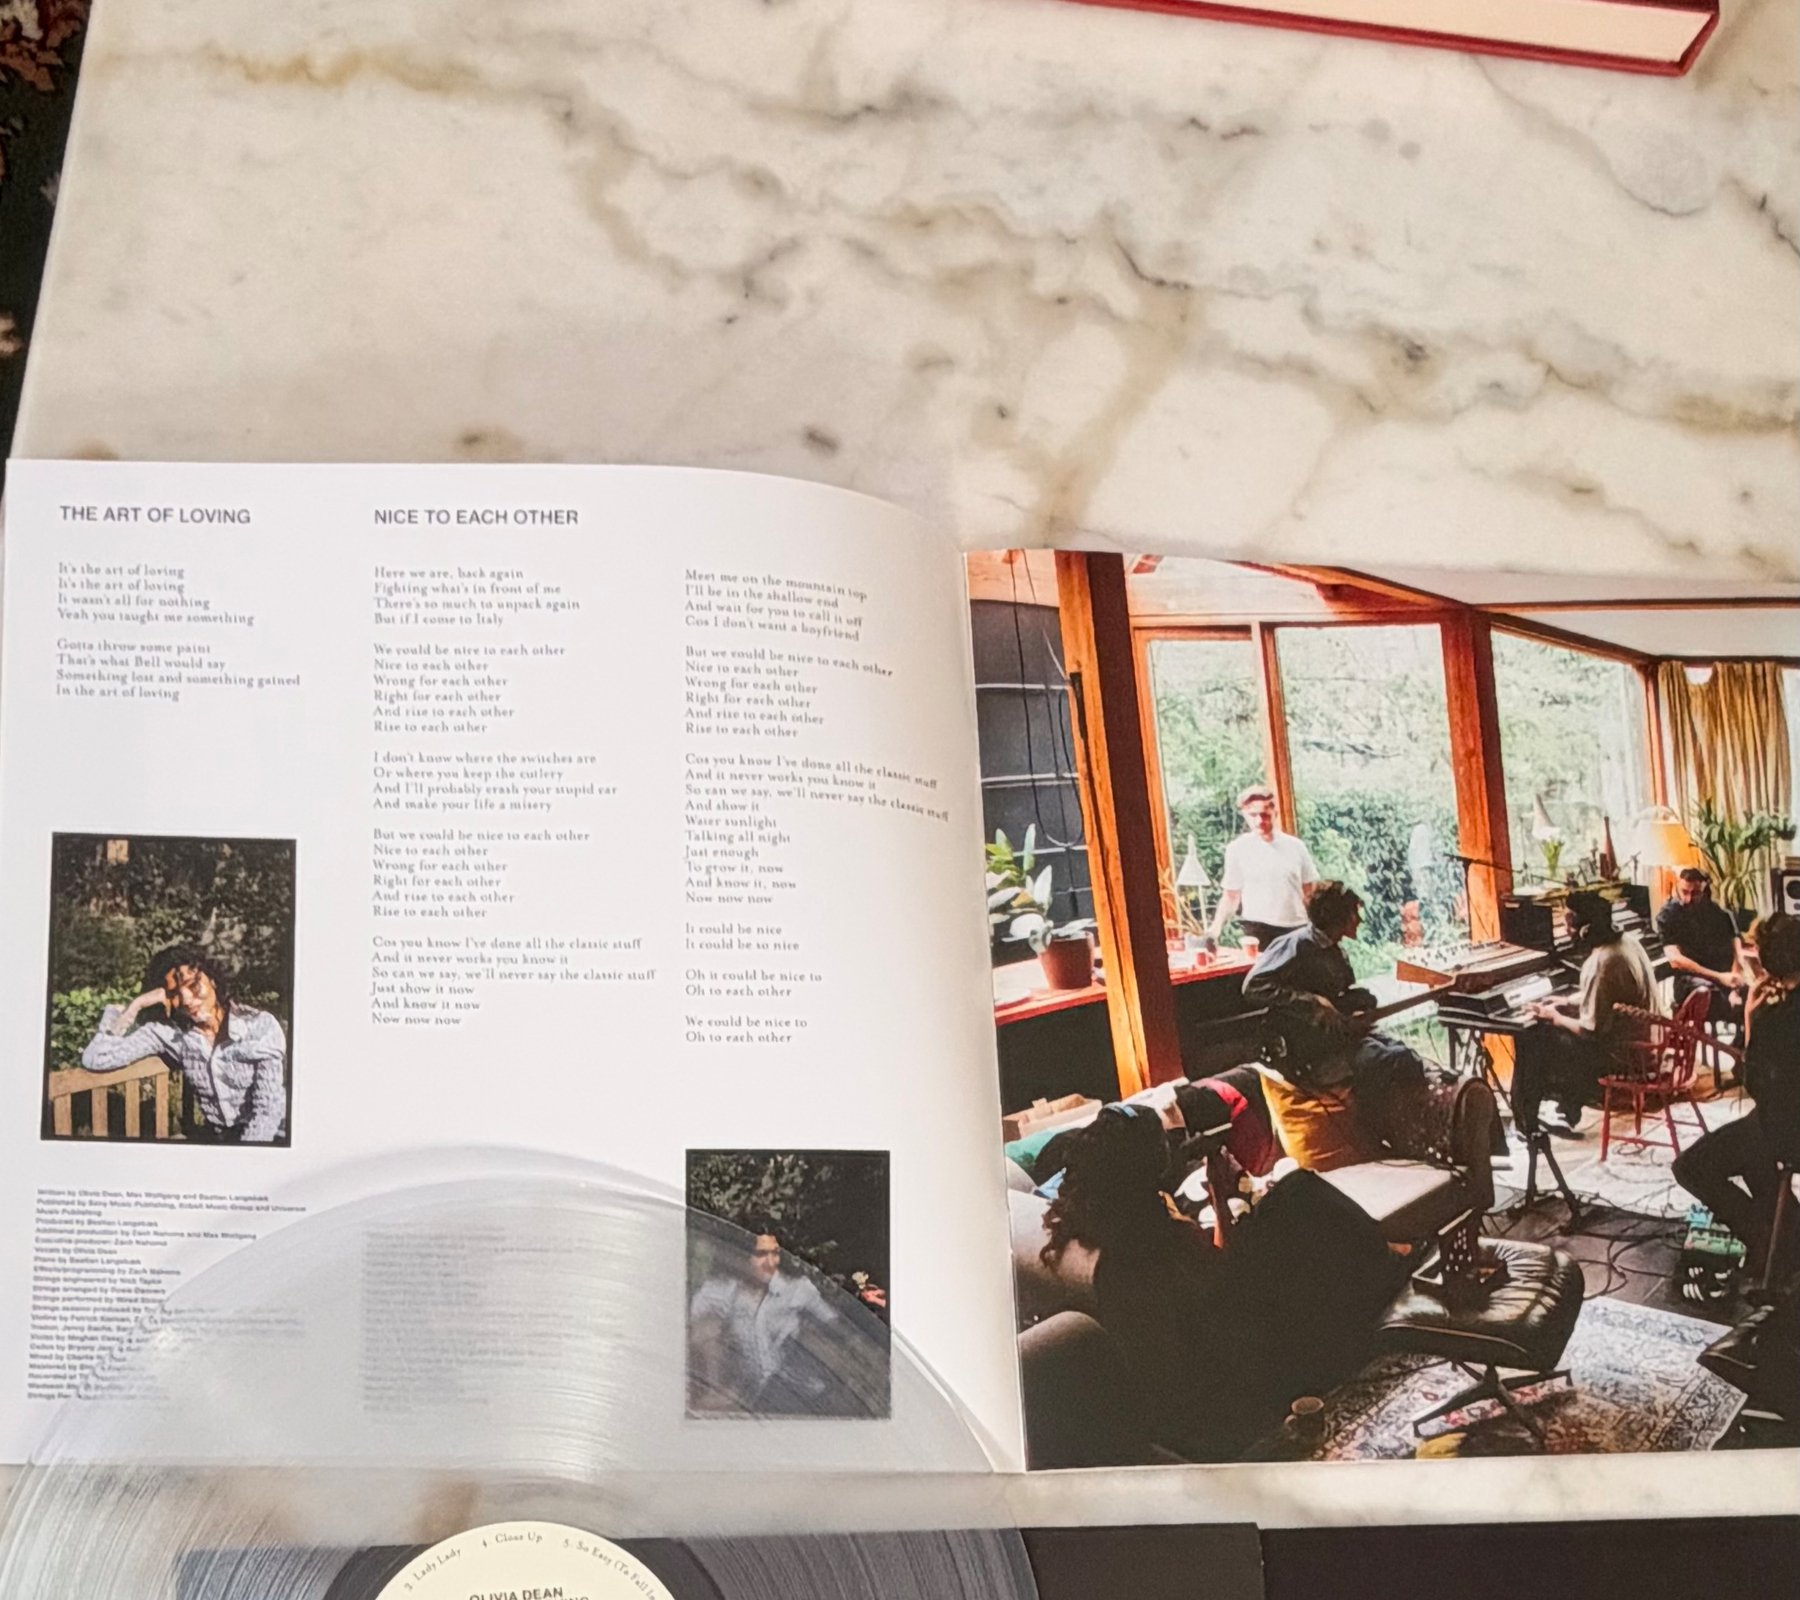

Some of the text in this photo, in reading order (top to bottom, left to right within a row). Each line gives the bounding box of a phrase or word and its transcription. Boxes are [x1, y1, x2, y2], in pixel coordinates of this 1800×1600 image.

[60, 505, 250, 523] THE ART OF LOVING
[374, 509, 578, 524] NICE TO EACH OTHER
[528, 1532, 543, 1543] Up
[414, 1548, 461, 1580] Lady Lady
[522, 1586, 563, 1600] DEAN
